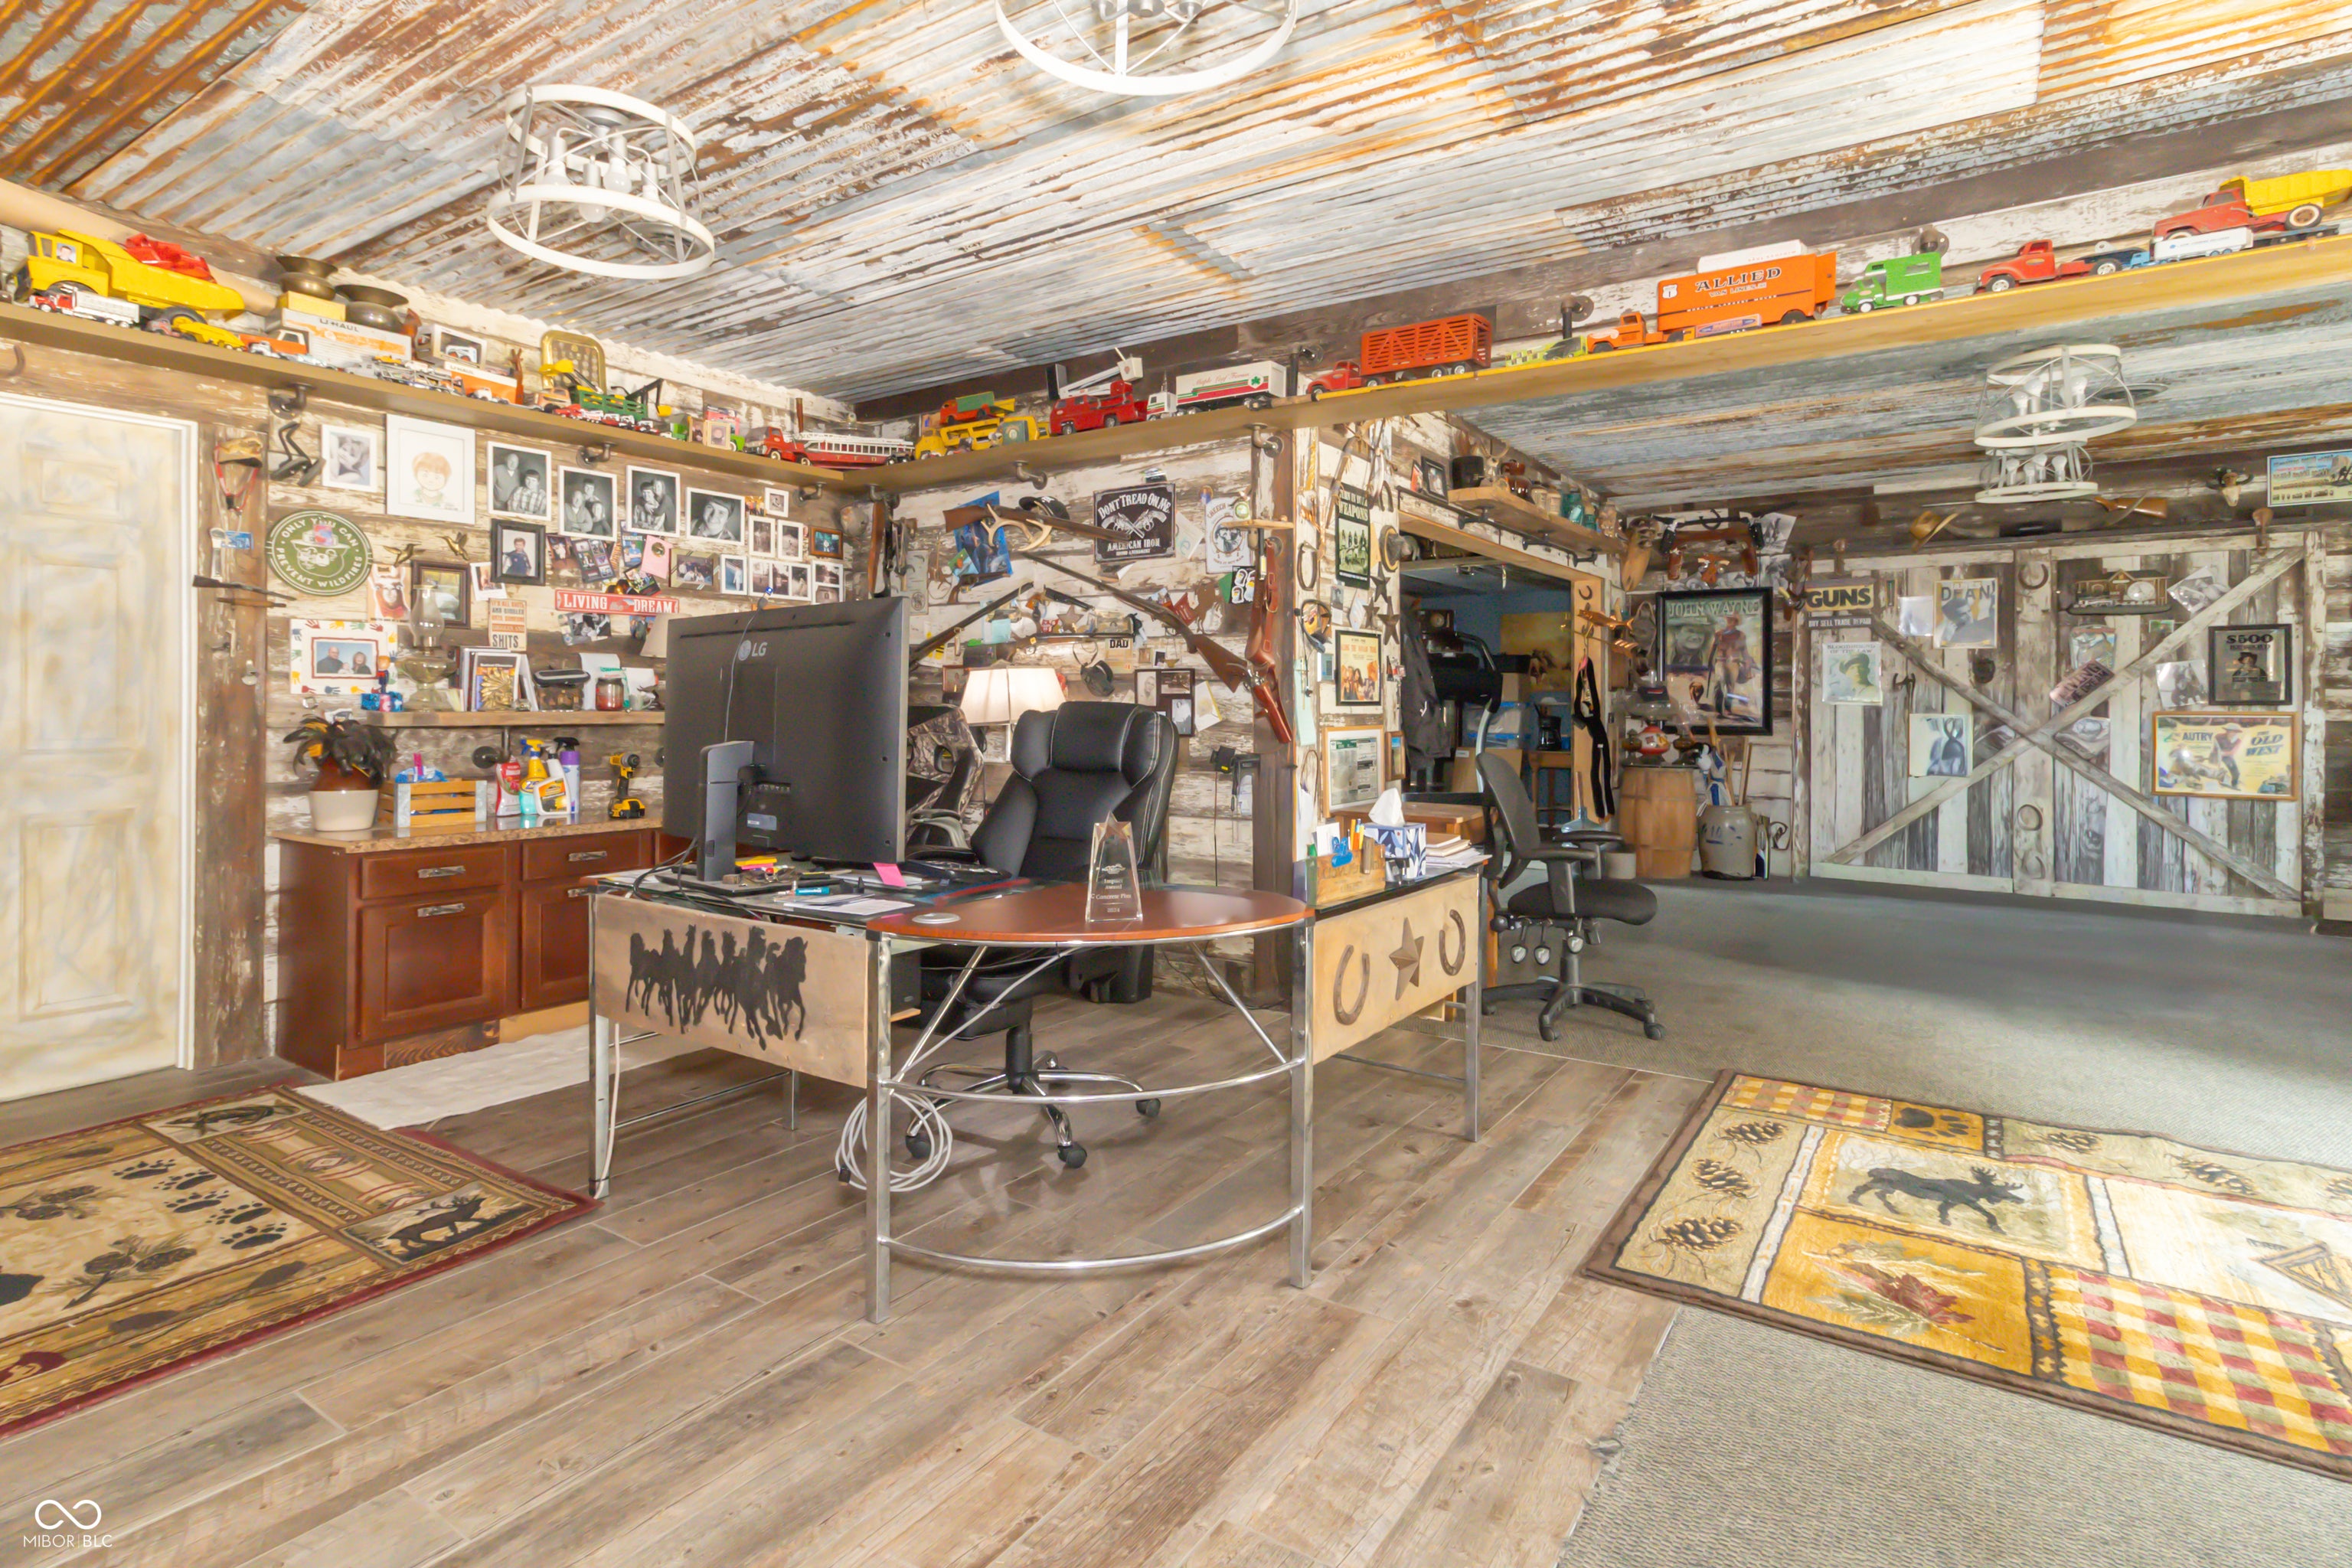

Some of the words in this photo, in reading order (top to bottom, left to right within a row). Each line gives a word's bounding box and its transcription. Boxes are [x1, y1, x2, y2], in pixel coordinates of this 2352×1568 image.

[1694, 267, 1782, 292] ALLIED
[1709, 289, 1727, 298] VAN
[1730, 284, 1756, 294] LINES
[1119, 493, 1147, 507] TREAD
[1148, 492, 1161, 507] ON
[1207, 502, 1227, 519] CHEECH
[1338, 502, 1368, 521] WEAPONS
[282, 519, 305, 537] ONLY
[338, 528, 359, 547] CAN
[1107, 540, 1142, 551] AMERICAN
[1144, 538, 1161, 547] IRON
[276, 547, 313, 586] PREVENT
[317, 556, 363, 588] WILDFIRES
[1808, 587, 1871, 608] GUNS
[1941, 585, 1991, 601] DEAN
[564, 593, 608, 610] LIVING
[633, 599, 673, 613] DREAM
[1669, 601, 1704, 617] JOHN
[1709, 599, 1760, 616] WAYNE
[1834, 618, 1851, 626] TRADE
[492, 634, 519, 648] SHITS
[1109, 639, 1129, 648] DAD
[752, 642, 768, 657] LG
[2182, 732, 2214, 742] AUTRY
[2251, 733, 2284, 746] OLD
[2246, 744, 2284, 756] WEST
